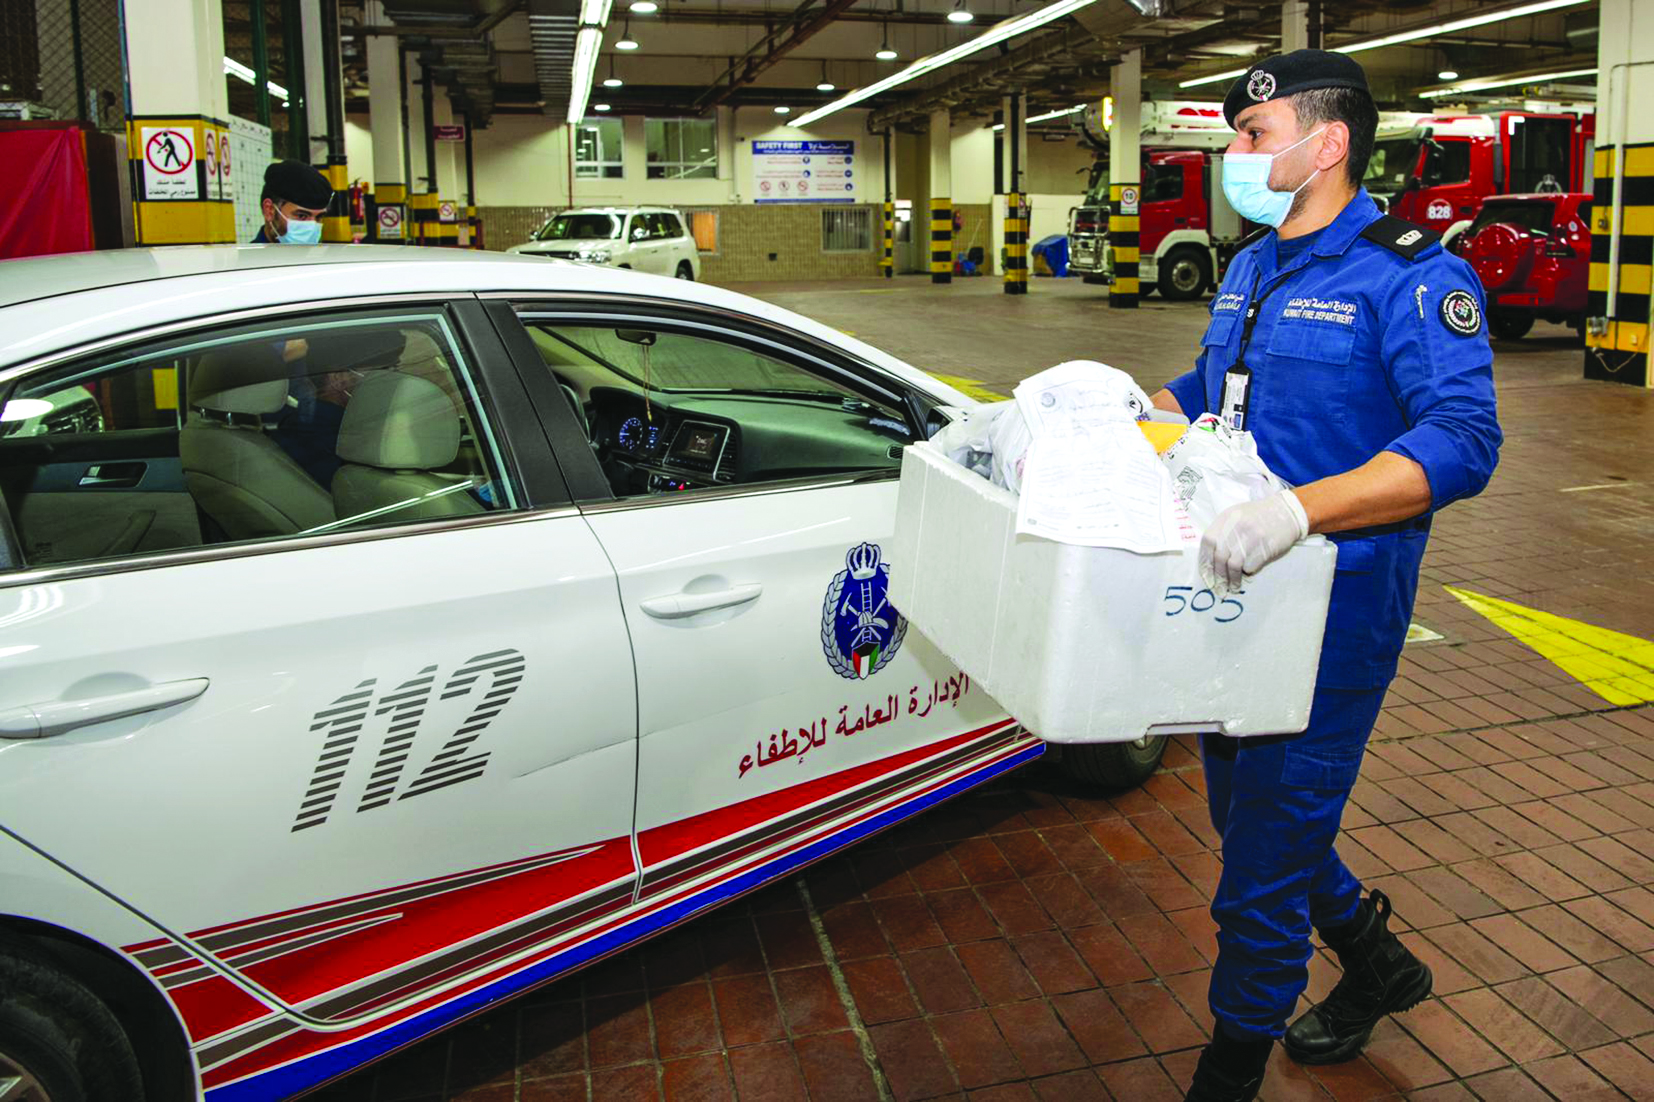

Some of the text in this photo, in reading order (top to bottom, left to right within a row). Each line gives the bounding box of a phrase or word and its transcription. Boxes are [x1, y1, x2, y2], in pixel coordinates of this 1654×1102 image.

[755, 141, 803, 150] SAFETY FIRST
[1428, 205, 1451, 220] 828
[1283, 308, 1355, 325] KUWAIT FIRE DEPARTMENT
[1164, 586, 1246, 623] 505
[738, 671, 970, 779] الإدارة العامة للإطفاء
[291, 648, 526, 833] 112
